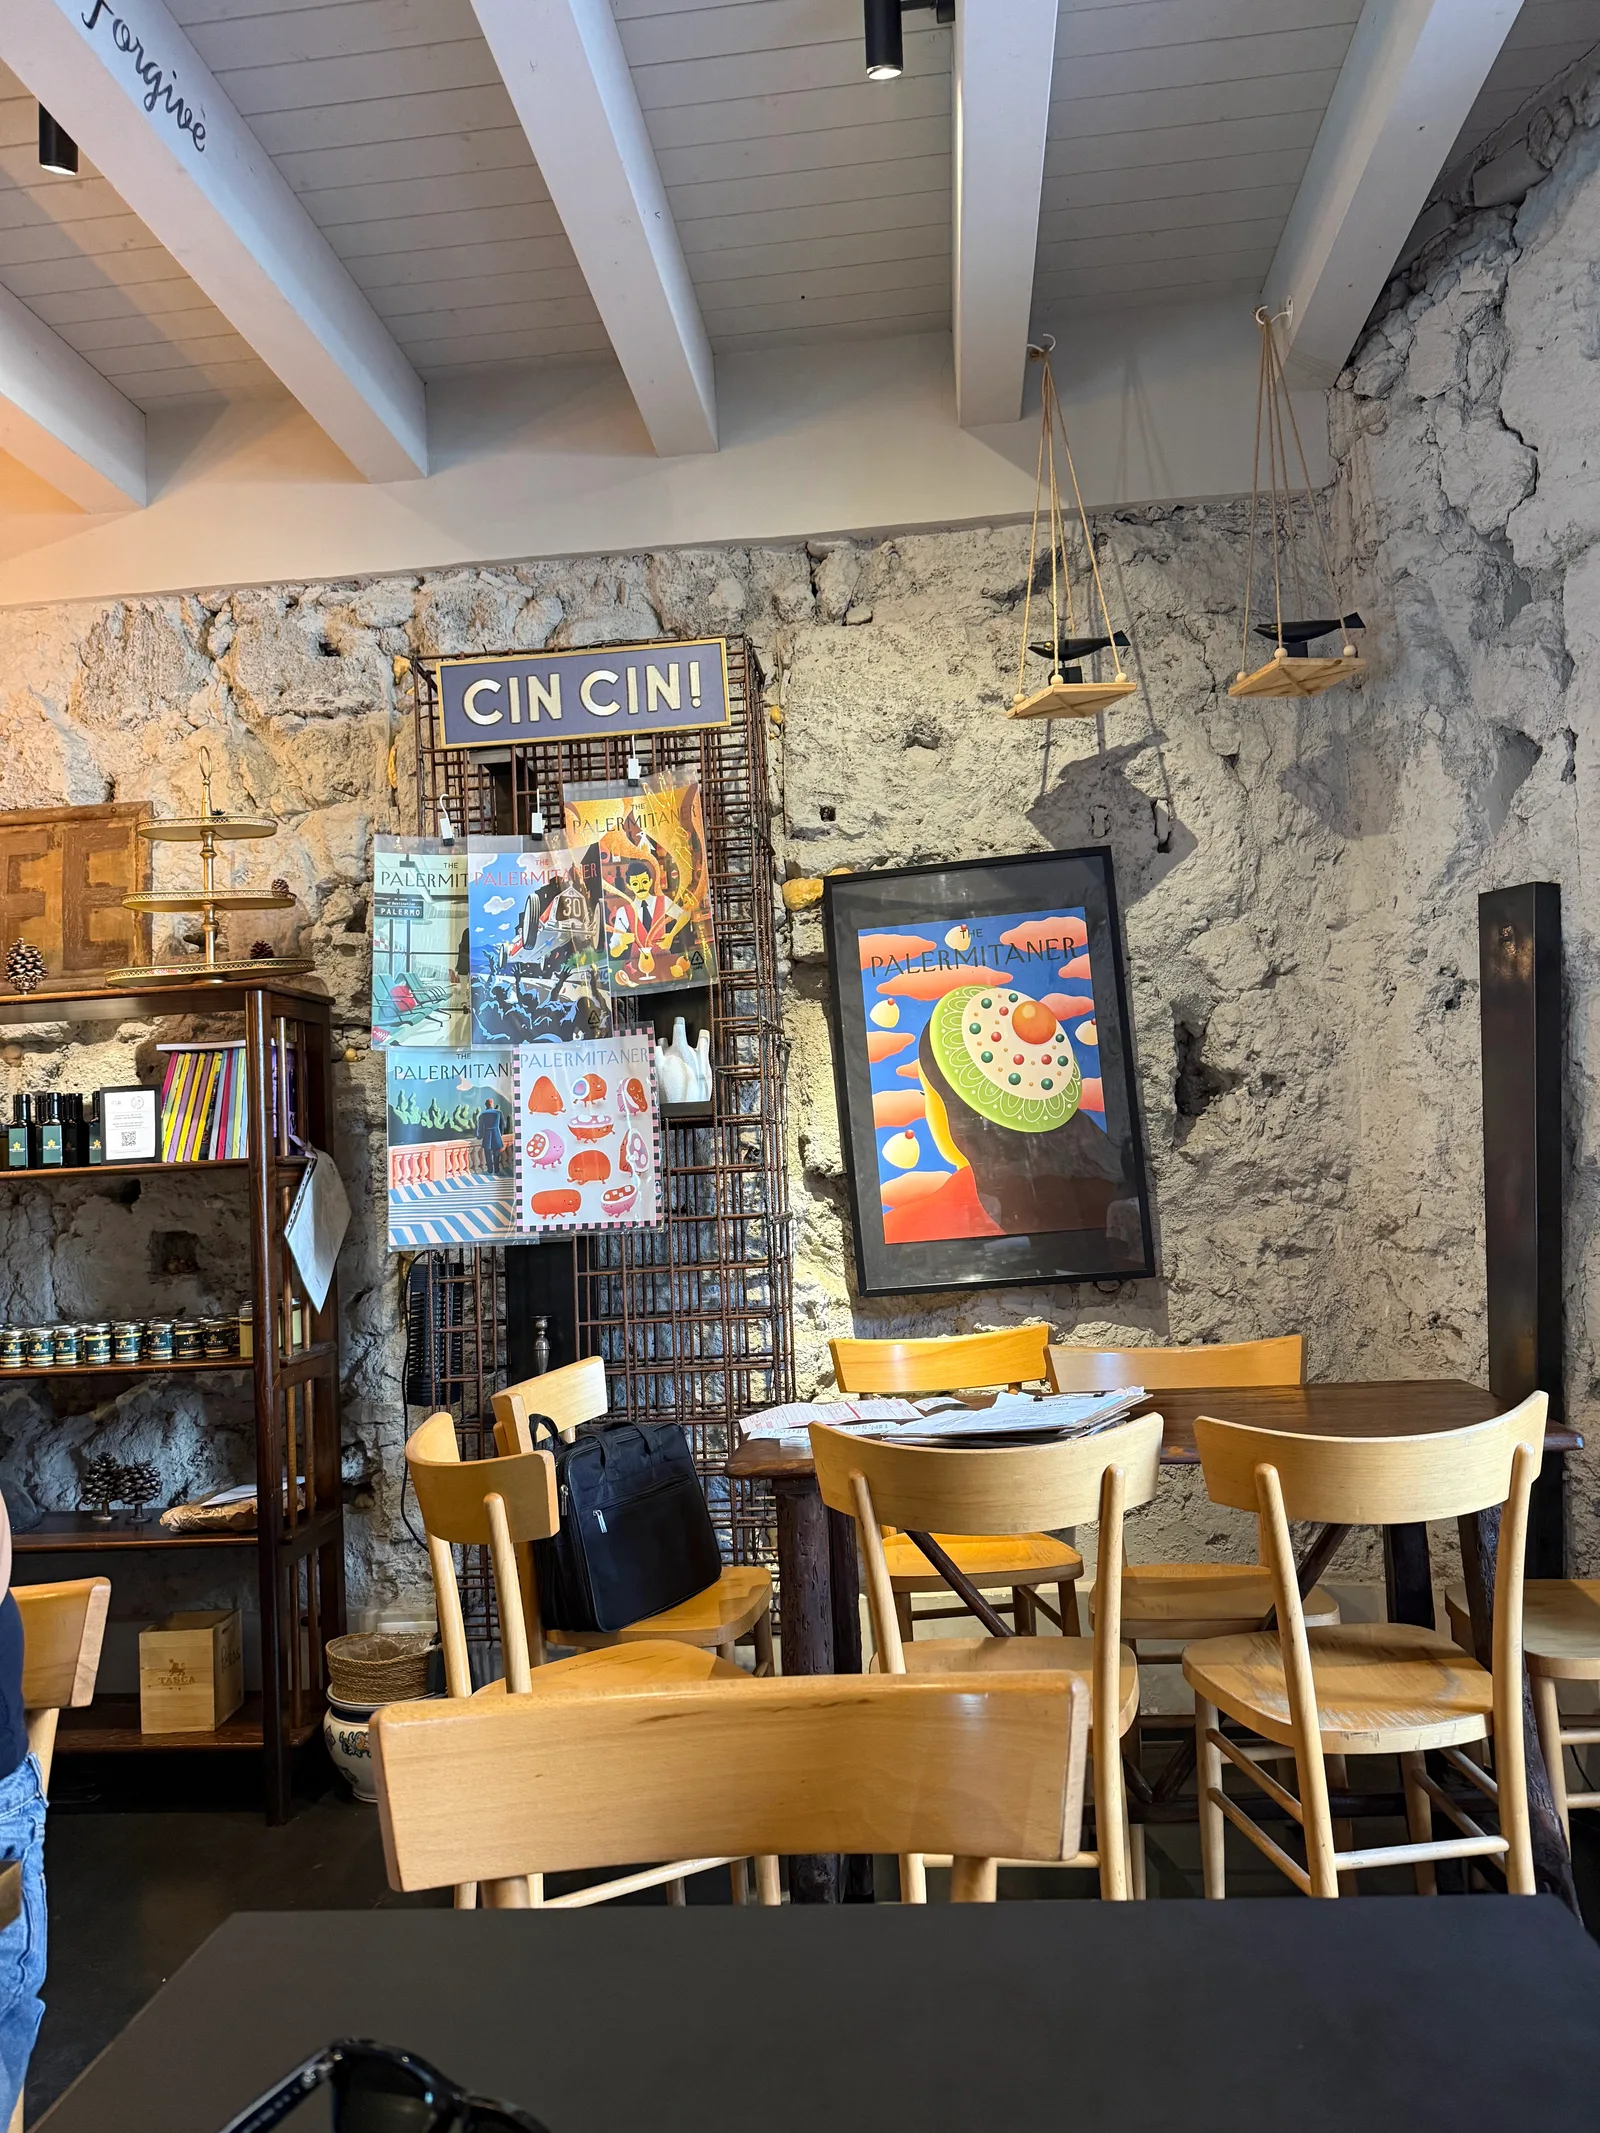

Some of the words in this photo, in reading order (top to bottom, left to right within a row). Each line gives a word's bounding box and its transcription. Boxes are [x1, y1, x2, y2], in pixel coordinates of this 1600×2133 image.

[462, 673, 562, 726] CIN
[579, 660, 702, 717] CIN!
[631, 802, 645, 810] THE
[380, 907, 421, 916] PALERMO
[562, 897, 582, 918] 30
[959, 928, 983, 940] THE
[870, 936, 1079, 978] PALERMITANER
[456, 1052, 471, 1060] THE
[519, 1047, 649, 1069] PALERMITANER
[158, 1675, 196, 1686] TASCA
